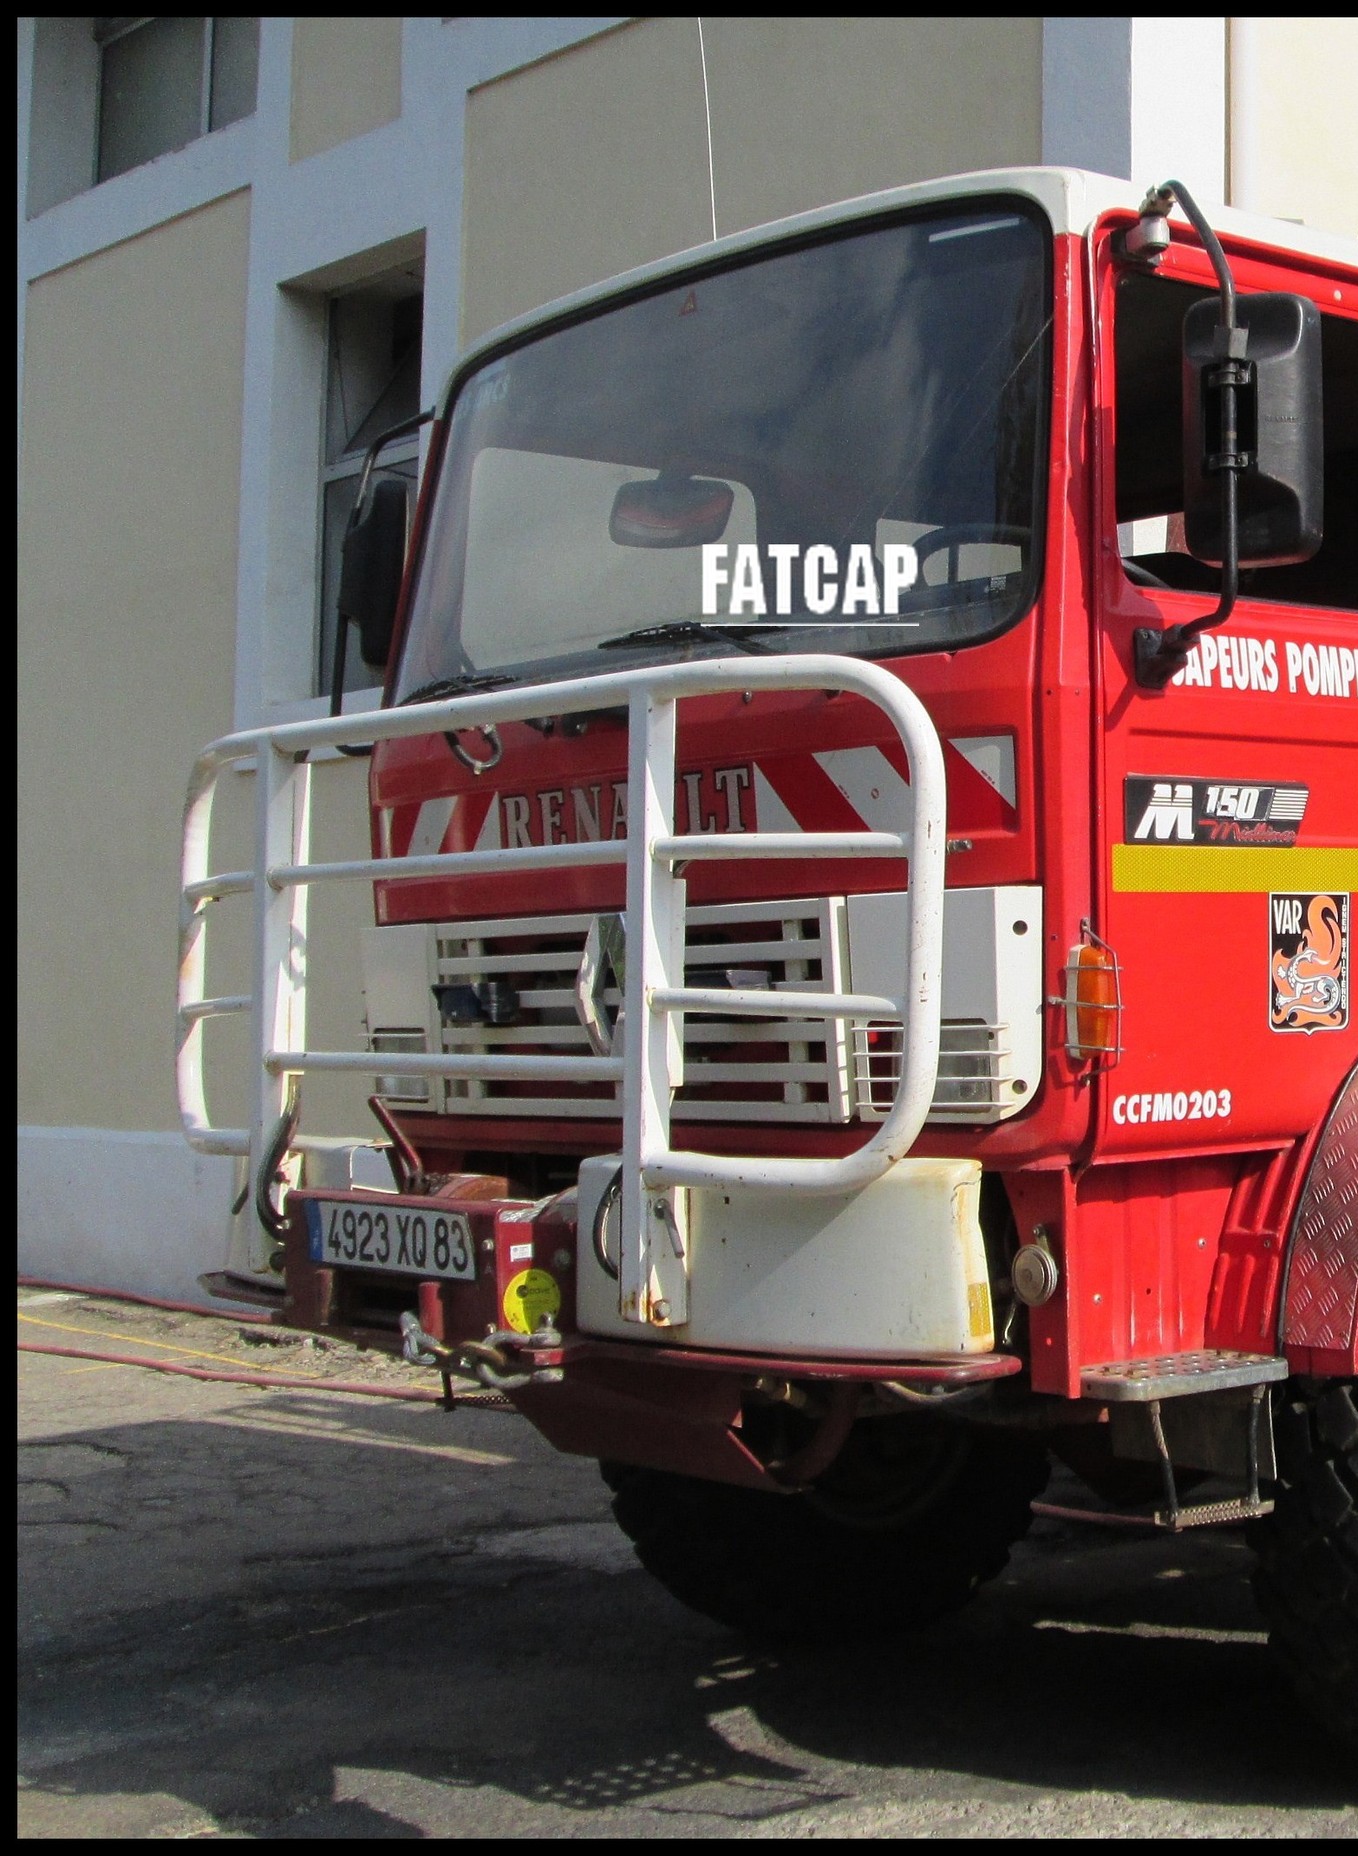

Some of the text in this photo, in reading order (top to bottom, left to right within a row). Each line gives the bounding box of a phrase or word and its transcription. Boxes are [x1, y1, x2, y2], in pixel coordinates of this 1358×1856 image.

[503, 768, 748, 847] RENALT
[1206, 786, 1260, 820] 150
[1273, 899, 1303, 935] VAR
[328, 1208, 468, 1273] 4923 XQ 83
